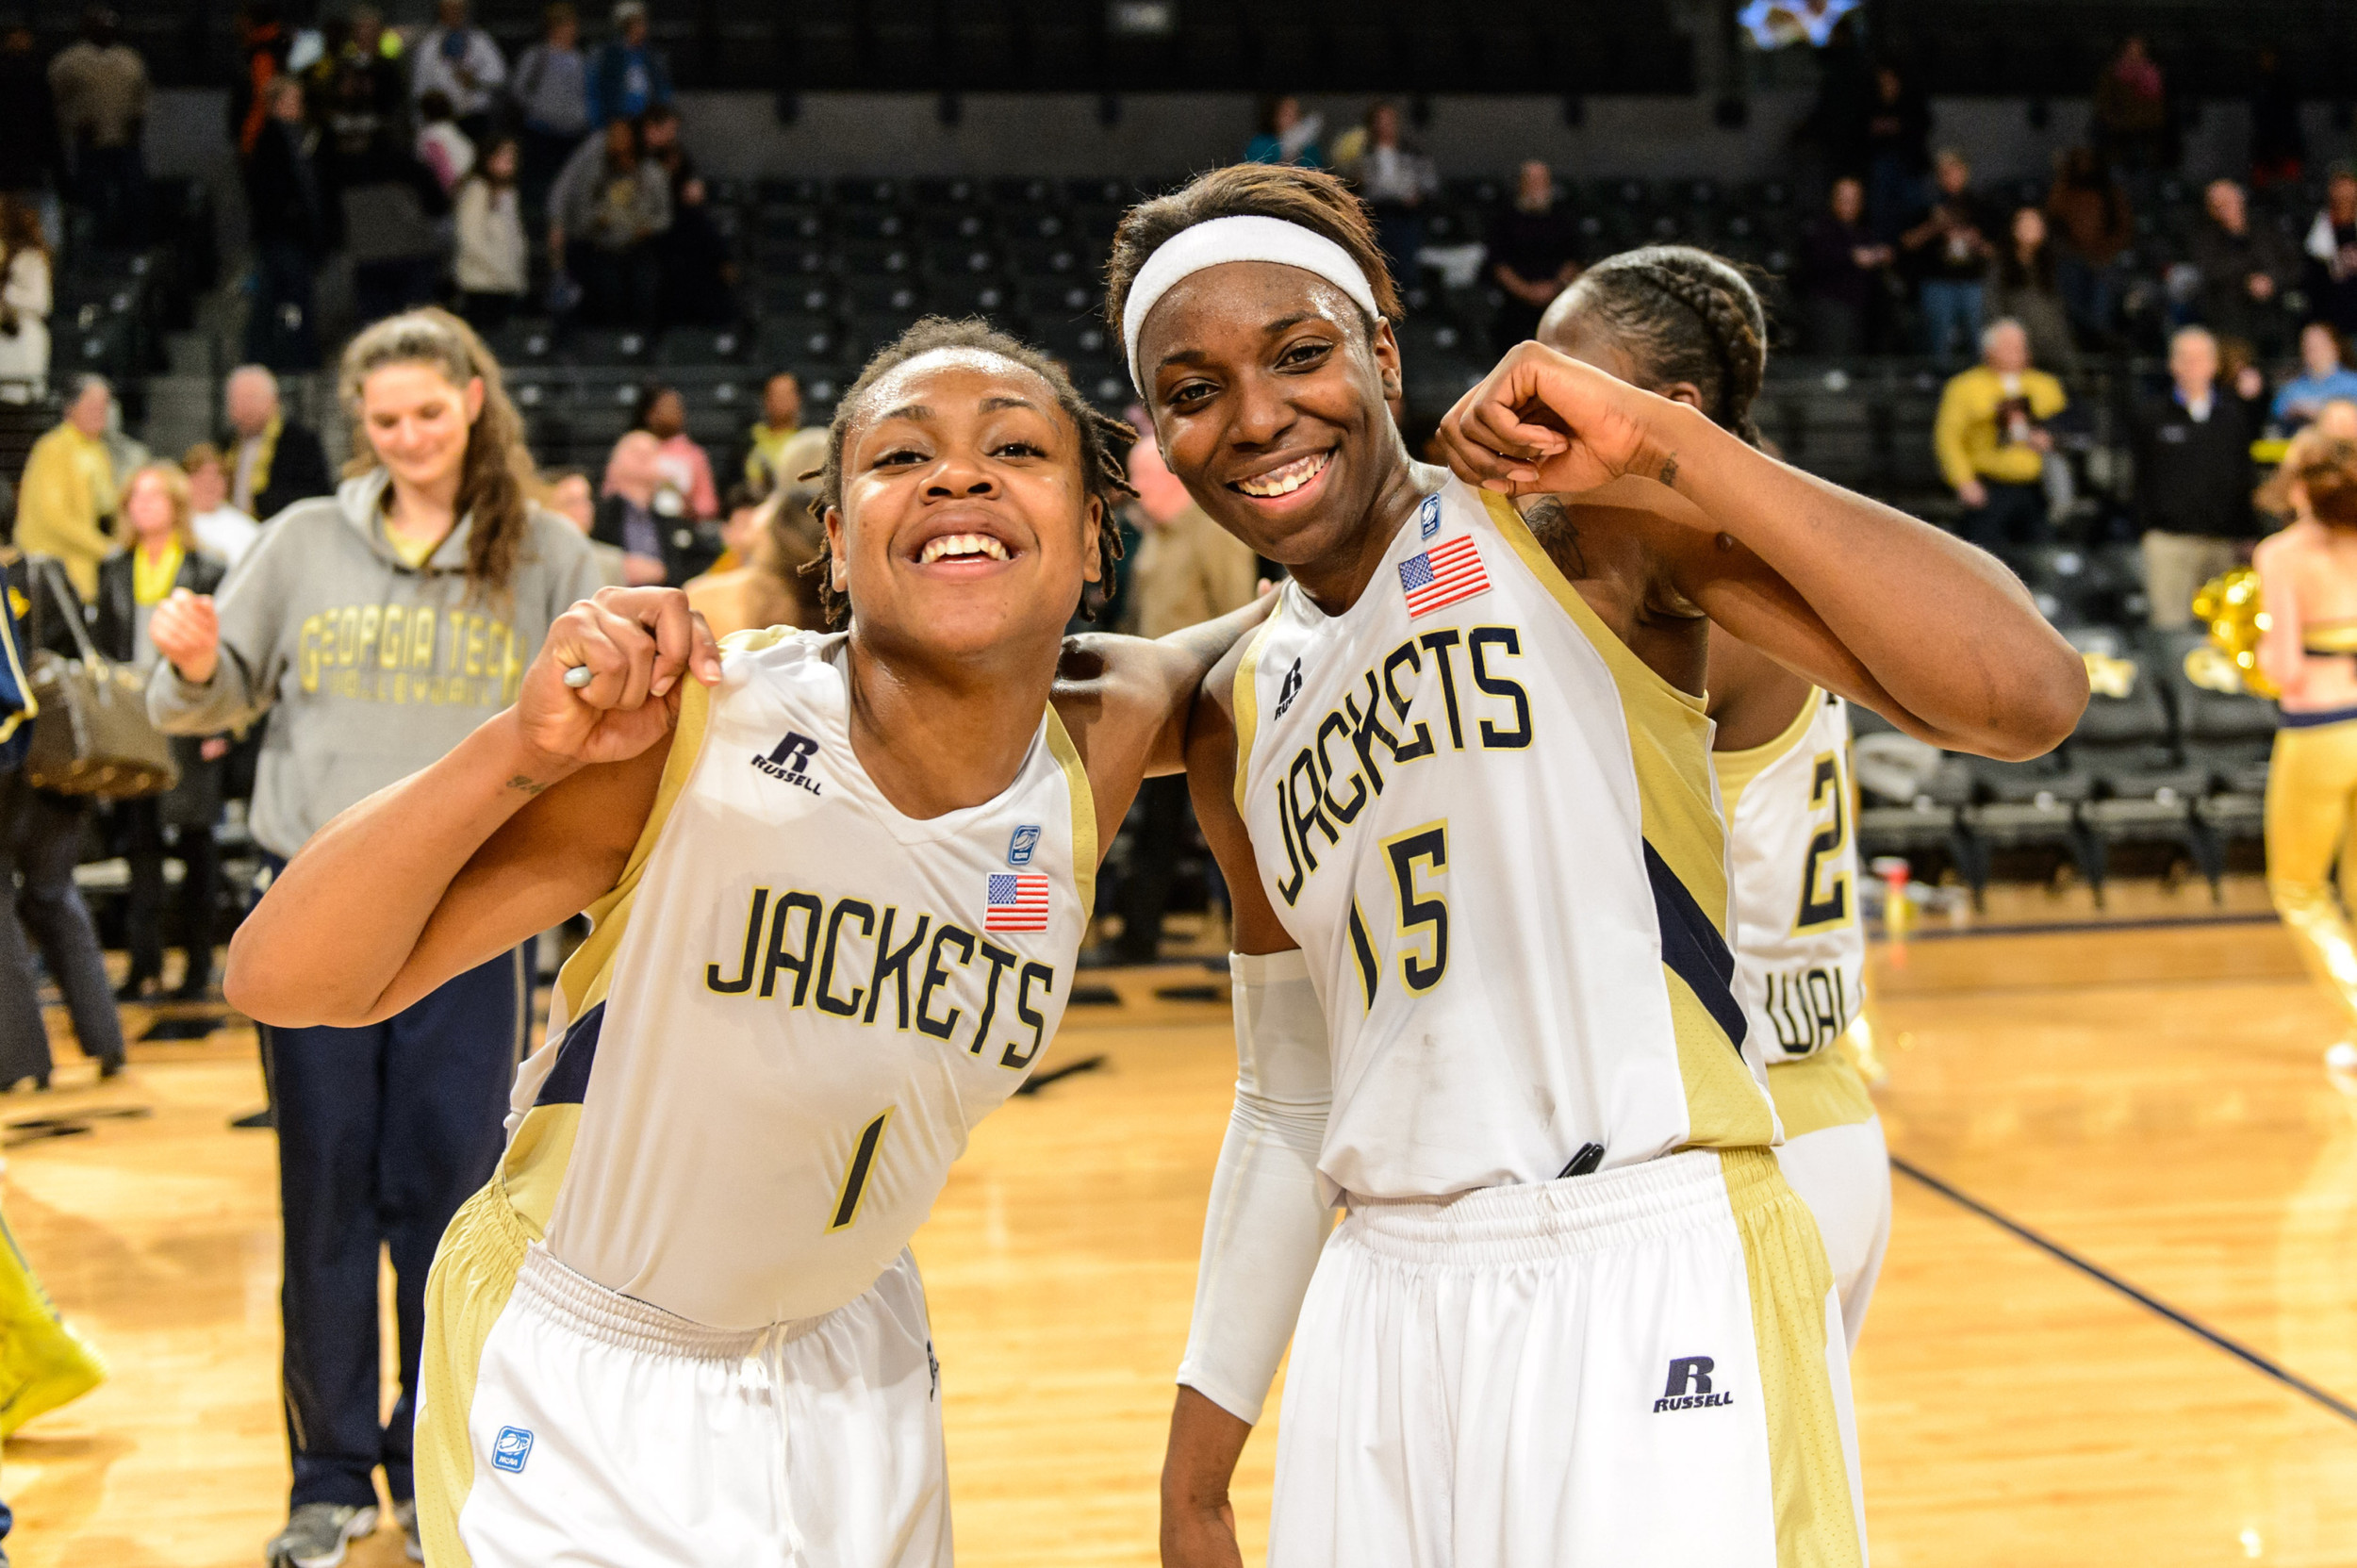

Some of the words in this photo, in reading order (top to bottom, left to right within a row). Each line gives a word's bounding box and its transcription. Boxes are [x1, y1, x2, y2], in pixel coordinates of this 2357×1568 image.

[299, 603, 436, 693] GEORGIA
[449, 610, 529, 705] TECH
[750, 753, 821, 796] RUSSELL
[767, 732, 818, 773] R
[1277, 623, 1535, 909] JACKETS
[1790, 749, 1854, 938] 2
[1346, 817, 1451, 1020] 15
[704, 885, 1055, 1070] JACKETS
[823, 1104, 897, 1235] 1
[1653, 1391, 1734, 1413] RUSSELL
[1664, 1356, 1714, 1397] R
